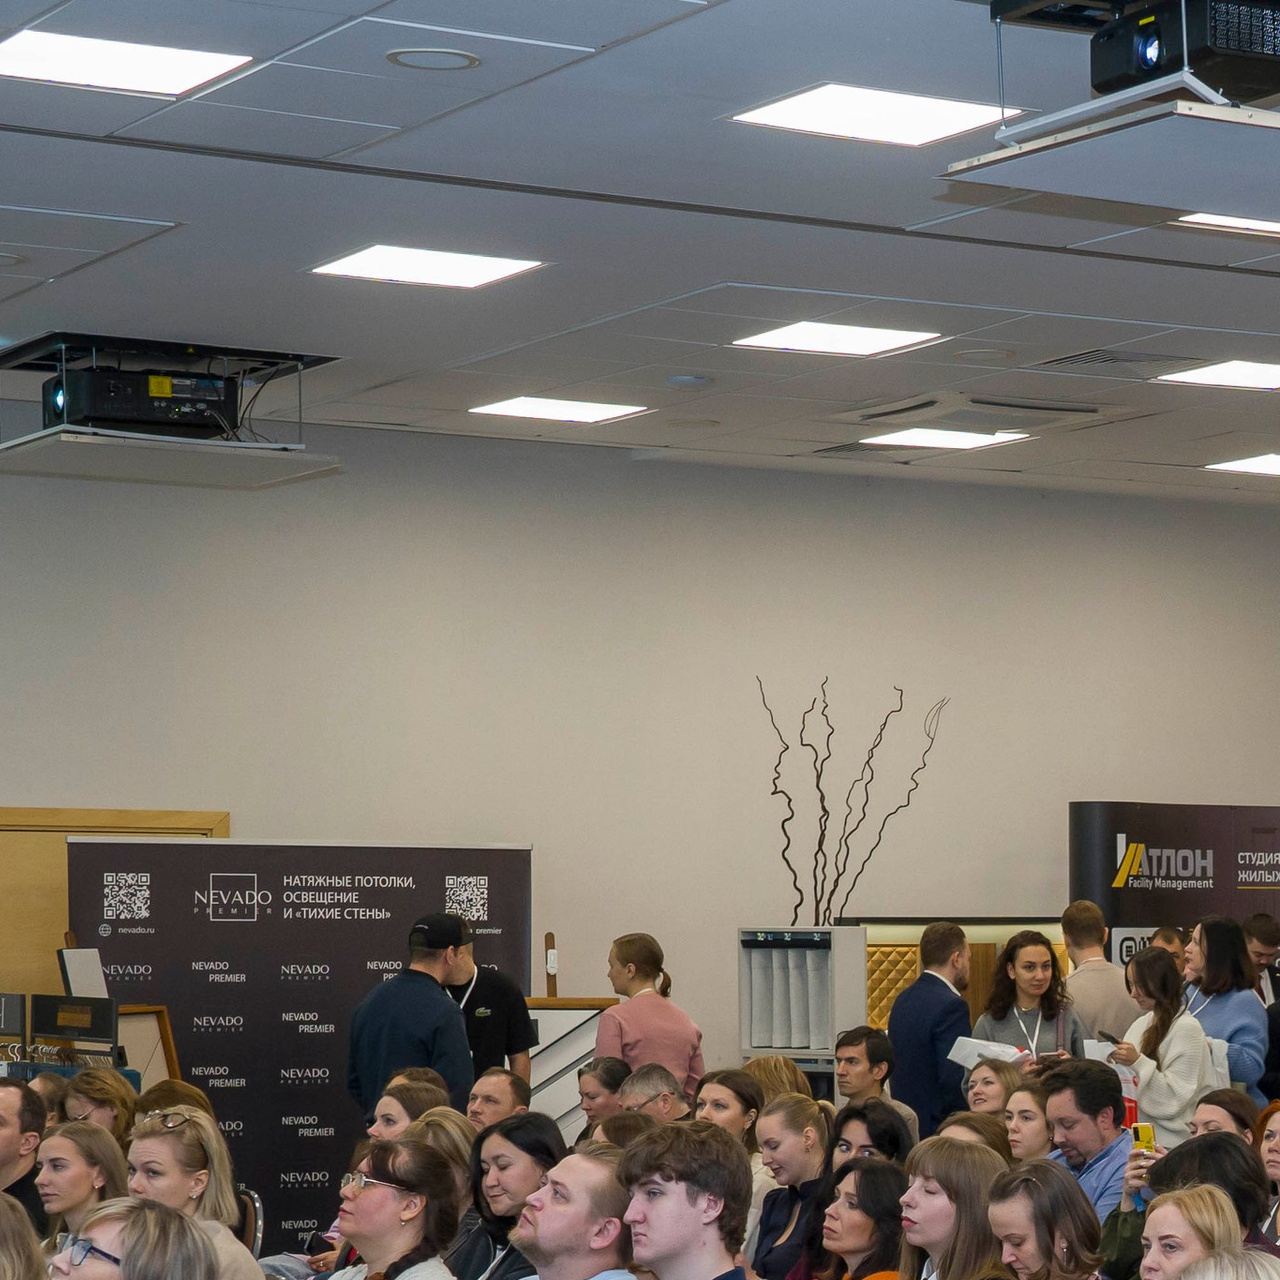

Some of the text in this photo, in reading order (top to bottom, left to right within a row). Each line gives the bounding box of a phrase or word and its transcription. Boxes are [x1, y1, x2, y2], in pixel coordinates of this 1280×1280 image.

[1129, 843, 1214, 878] АТЛОН
[1237, 852, 1280, 867] СТУДИЯ
[283, 875, 416, 889] НАТЯЖНЫЕ ПОТОЛКИ,
[1128, 876, 1214, 890] Facility Management
[194, 890, 272, 905] NEVADO
[283, 892, 359, 905] ОСВЕЩЕНИЕ
[283, 908, 391, 919] И «ТИХИЕ СТЕНЫ»
[118, 926, 155, 934] nevado.ru
[191, 961, 229, 971] NEVADO
[281, 964, 330, 975] NEVADO
[367, 961, 402, 970] NEVADO
[208, 973, 246, 983] PREMIER
[193, 1016, 244, 1026] NEVADO
[282, 1012, 319, 1021] NEVADO
[298, 1024, 335, 1033] PREMIER
[192, 1066, 229, 1076] NEVADO
[280, 1068, 330, 1078] NEVADO
[208, 1078, 246, 1088] PREMIER
[282, 1115, 318, 1125] NEVADO
[298, 1127, 335, 1137] PREMIER
[280, 1171, 330, 1183] NEVADO
[281, 1219, 318, 1229] NEVADO
